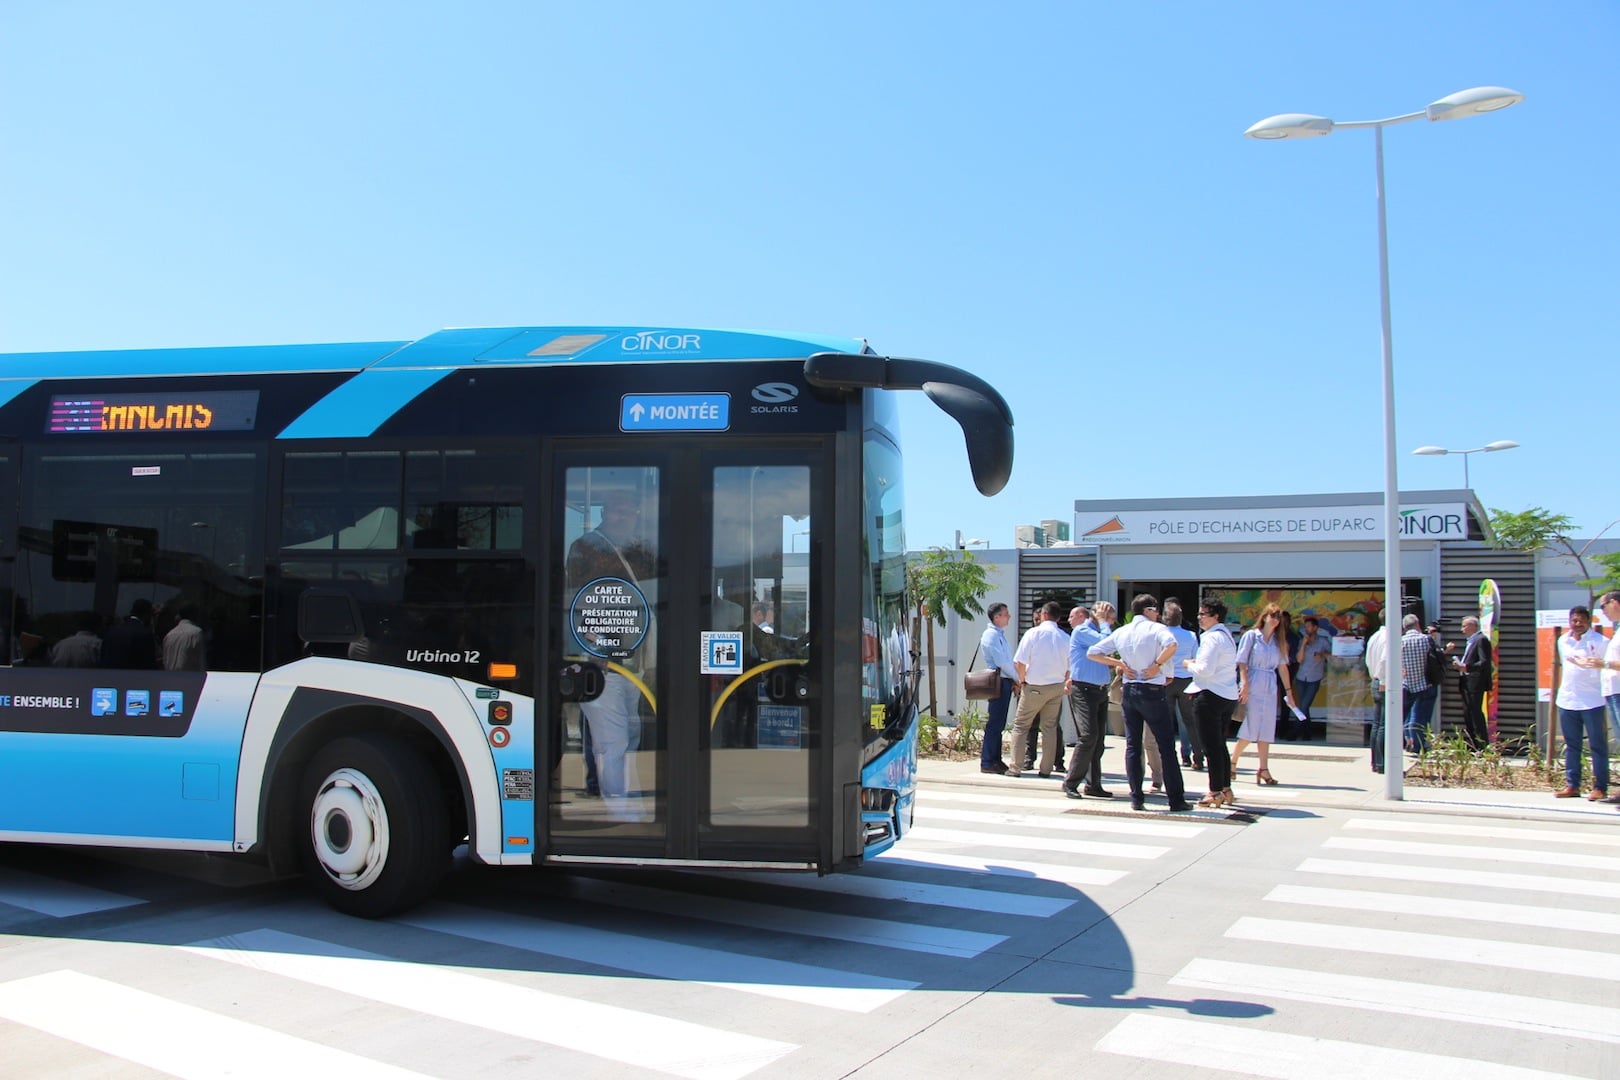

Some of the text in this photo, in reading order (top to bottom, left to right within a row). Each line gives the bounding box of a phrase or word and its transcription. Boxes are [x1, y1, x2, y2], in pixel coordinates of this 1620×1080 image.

[621, 333, 700, 350] CINOR
[650, 402, 719, 420] MONTÉE
[1149, 518, 1375, 534] PÔLE D'ECHANGES DE DUPARC
[594, 586, 623, 595] CARTE
[585, 595, 632, 604] OU TICKET
[581, 608, 638, 617] PRÉSENTATION
[590, 626, 642, 634] CONDUCTEUR.
[596, 638, 620, 647] MERCI
[406, 650, 480, 663] Urbino 12
[14, 695, 73, 709] ENSEMBLE
